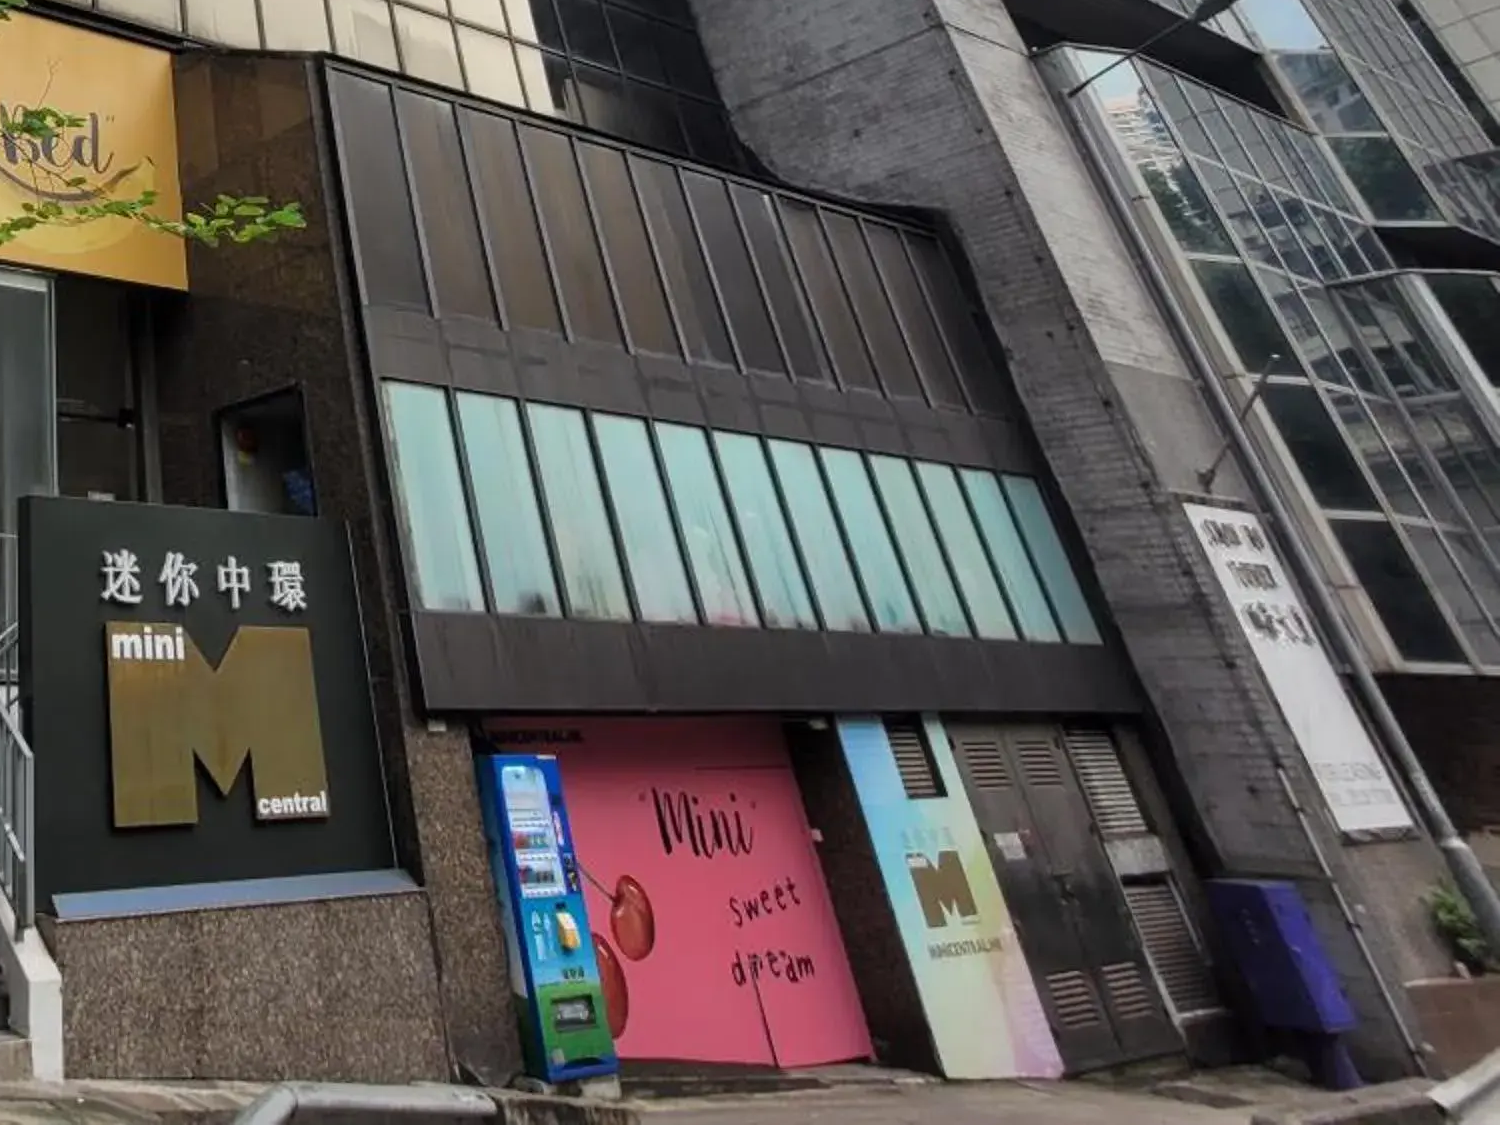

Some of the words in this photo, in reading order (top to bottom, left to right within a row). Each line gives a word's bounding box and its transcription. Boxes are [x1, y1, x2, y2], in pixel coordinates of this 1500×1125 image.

[100, 549, 308, 612] 迷你中環
[111, 625, 186, 660] mini
[105, 620, 332, 828] M
[257, 789, 328, 816] central
[729, 876, 802, 928] sweet
[731, 948, 816, 987] dream
